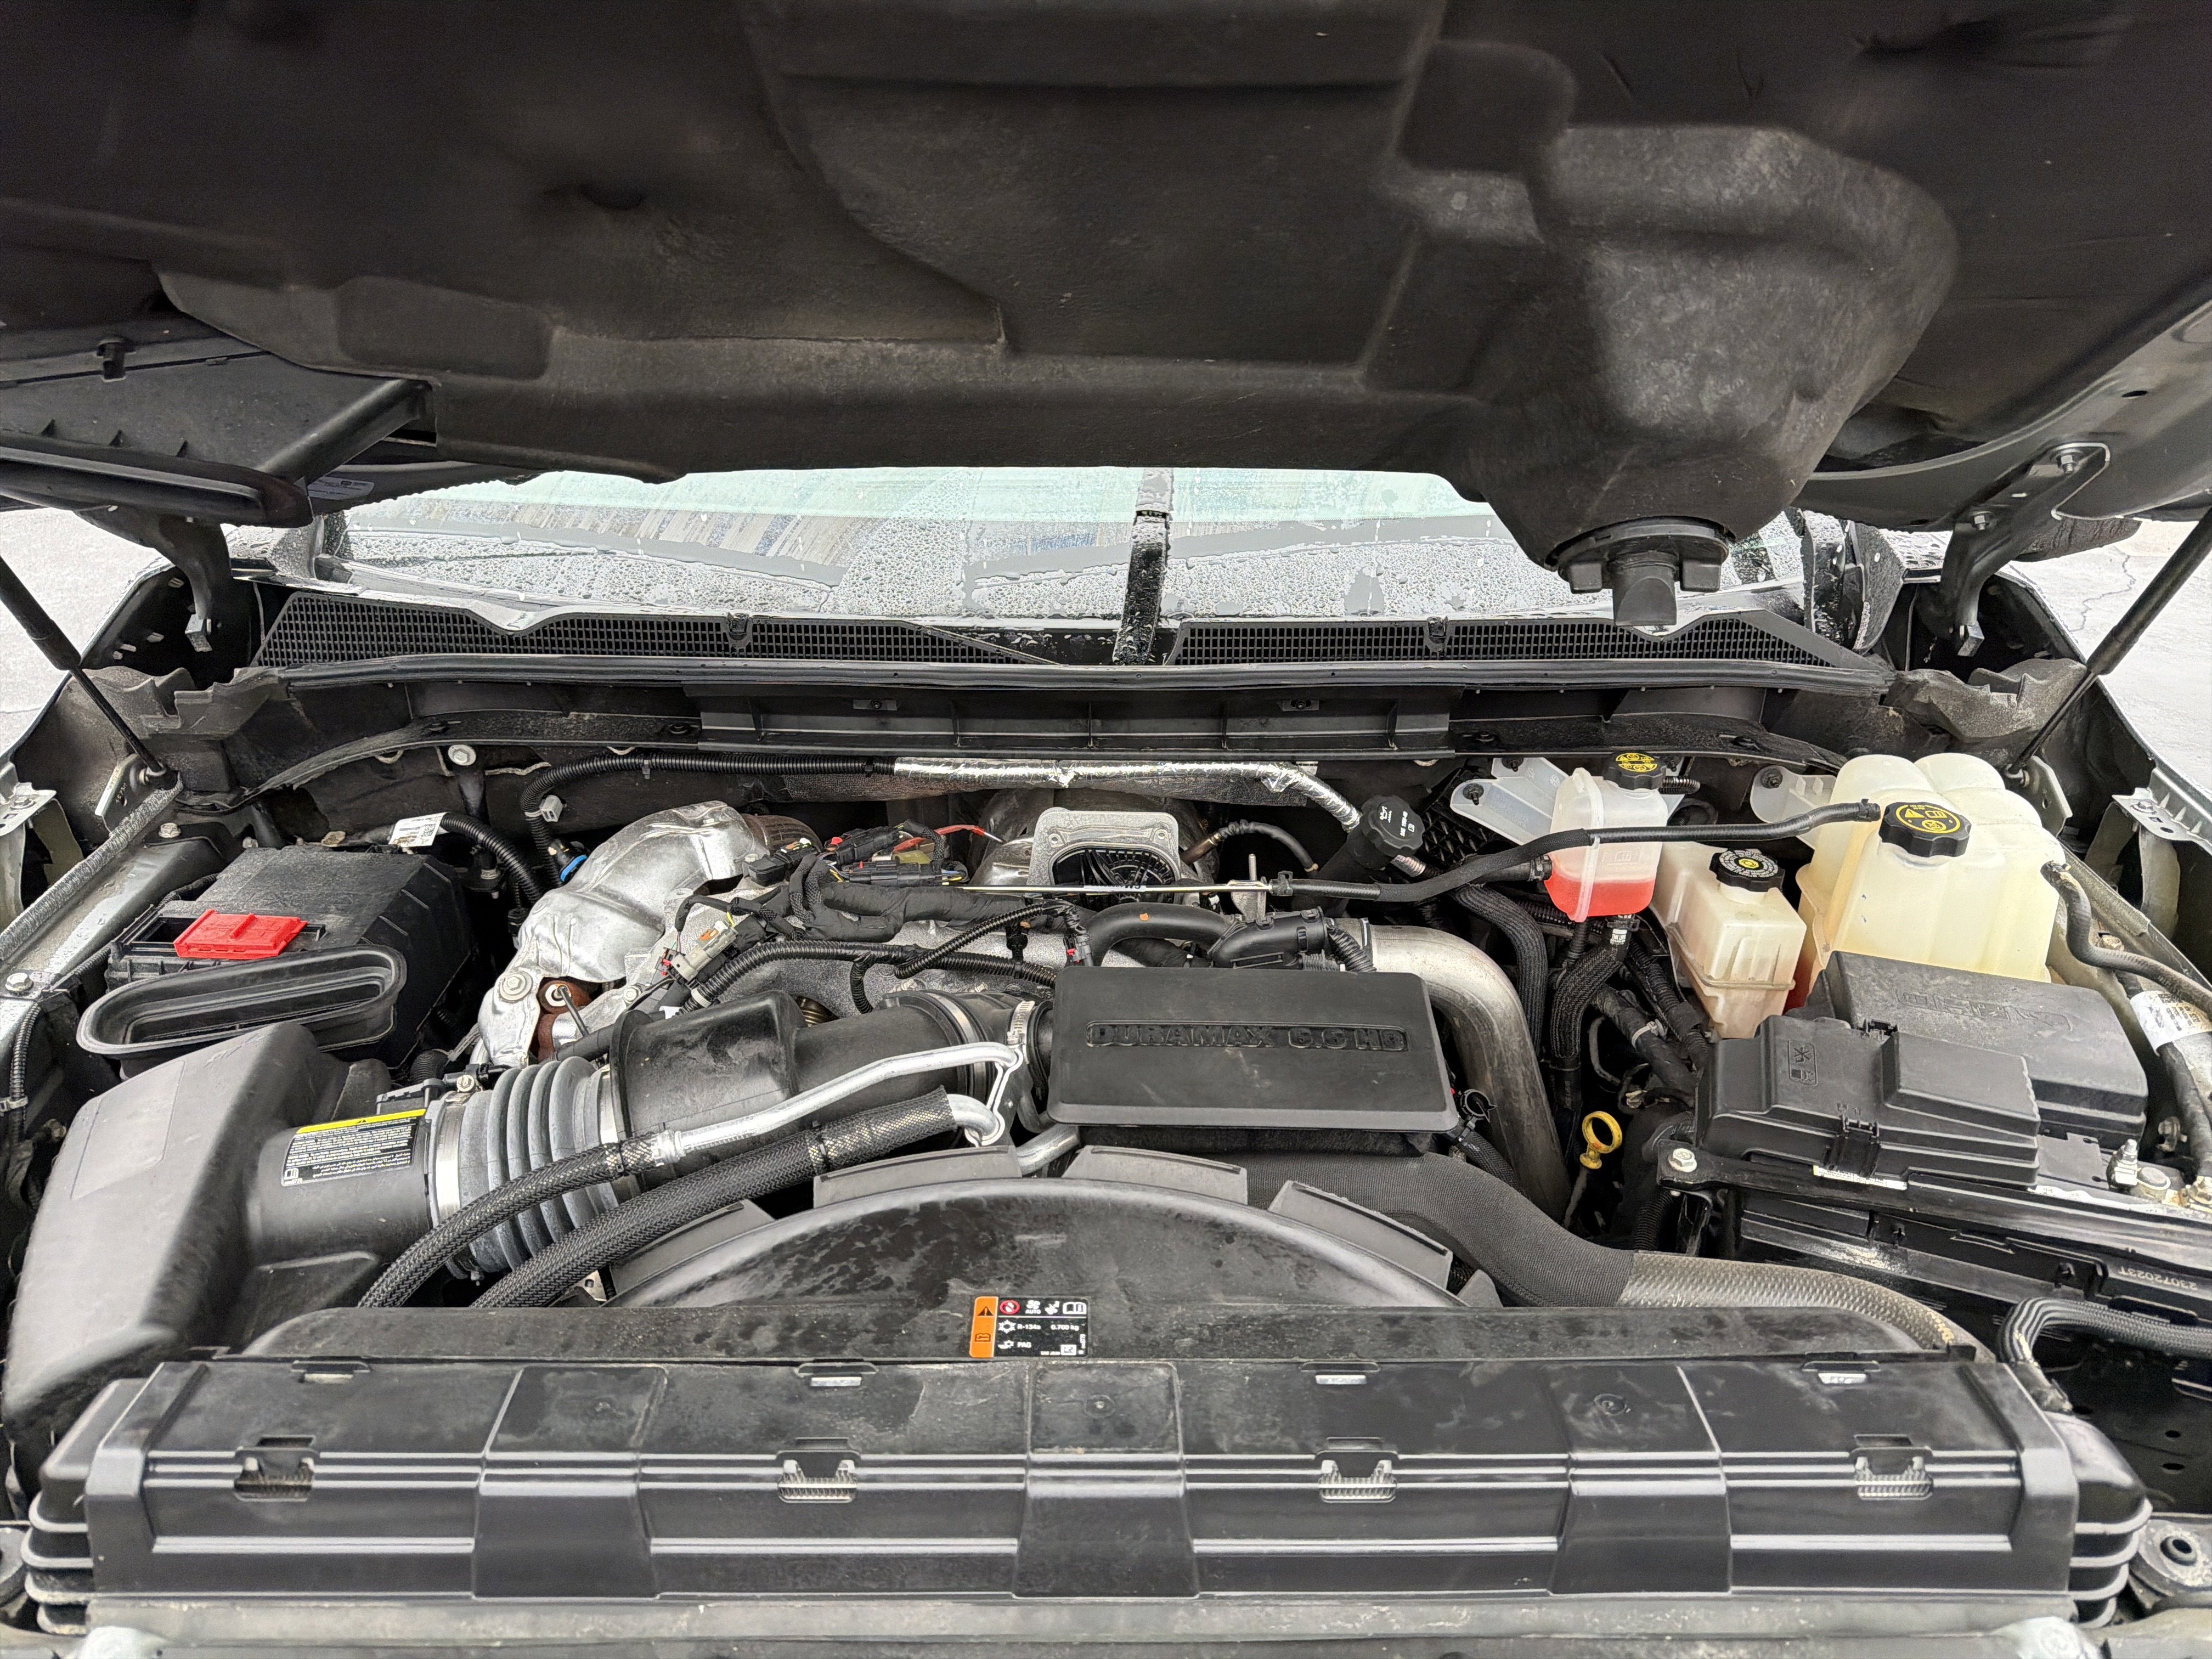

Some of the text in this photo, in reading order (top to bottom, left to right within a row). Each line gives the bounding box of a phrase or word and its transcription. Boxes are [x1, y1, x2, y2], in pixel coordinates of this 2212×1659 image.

[1086, 1024, 1408, 1051] DURAMAX 6.6 HD
[2118, 1266, 2198, 1290] 23072023T
